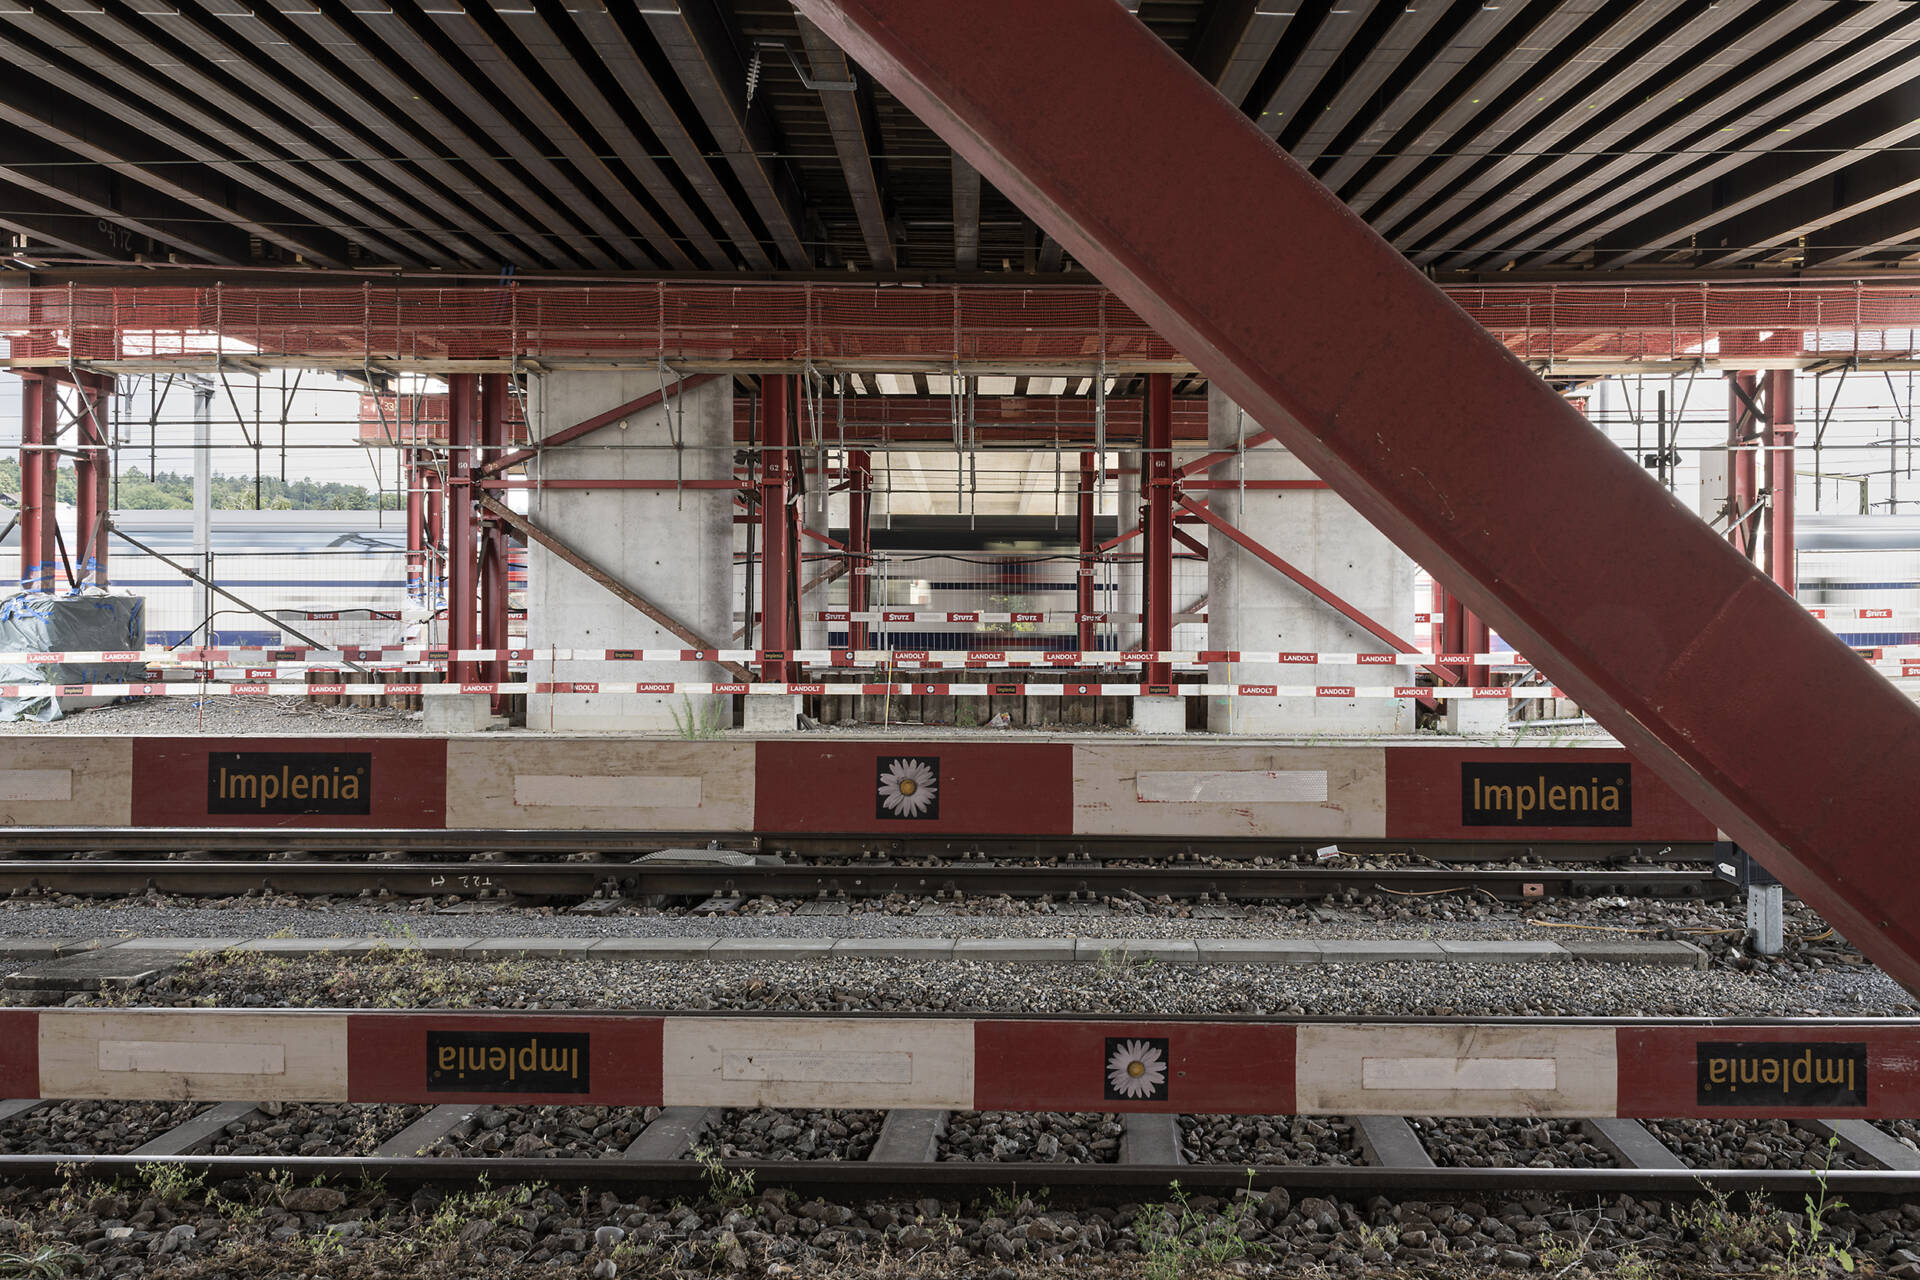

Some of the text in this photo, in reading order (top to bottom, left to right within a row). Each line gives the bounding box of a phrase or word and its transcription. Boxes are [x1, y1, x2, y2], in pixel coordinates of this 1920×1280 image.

[769, 464, 780, 472] 62
[888, 613, 910, 621] STUTZ
[104, 653, 135, 661] LANDOLT
[895, 652, 926, 660] LANDOLT
[1046, 653, 1077, 661] LANDOLT
[1123, 653, 1154, 661] LANDOLT
[1283, 655, 1315, 663] LANDOLT
[251, 670, 272, 678] STUTZ
[574, 684, 595, 692] NDOLT
[640, 684, 670, 692] LANDOLT
[715, 684, 746, 692] LANDOLT
[1397, 688, 1428, 696] LANDOLT
